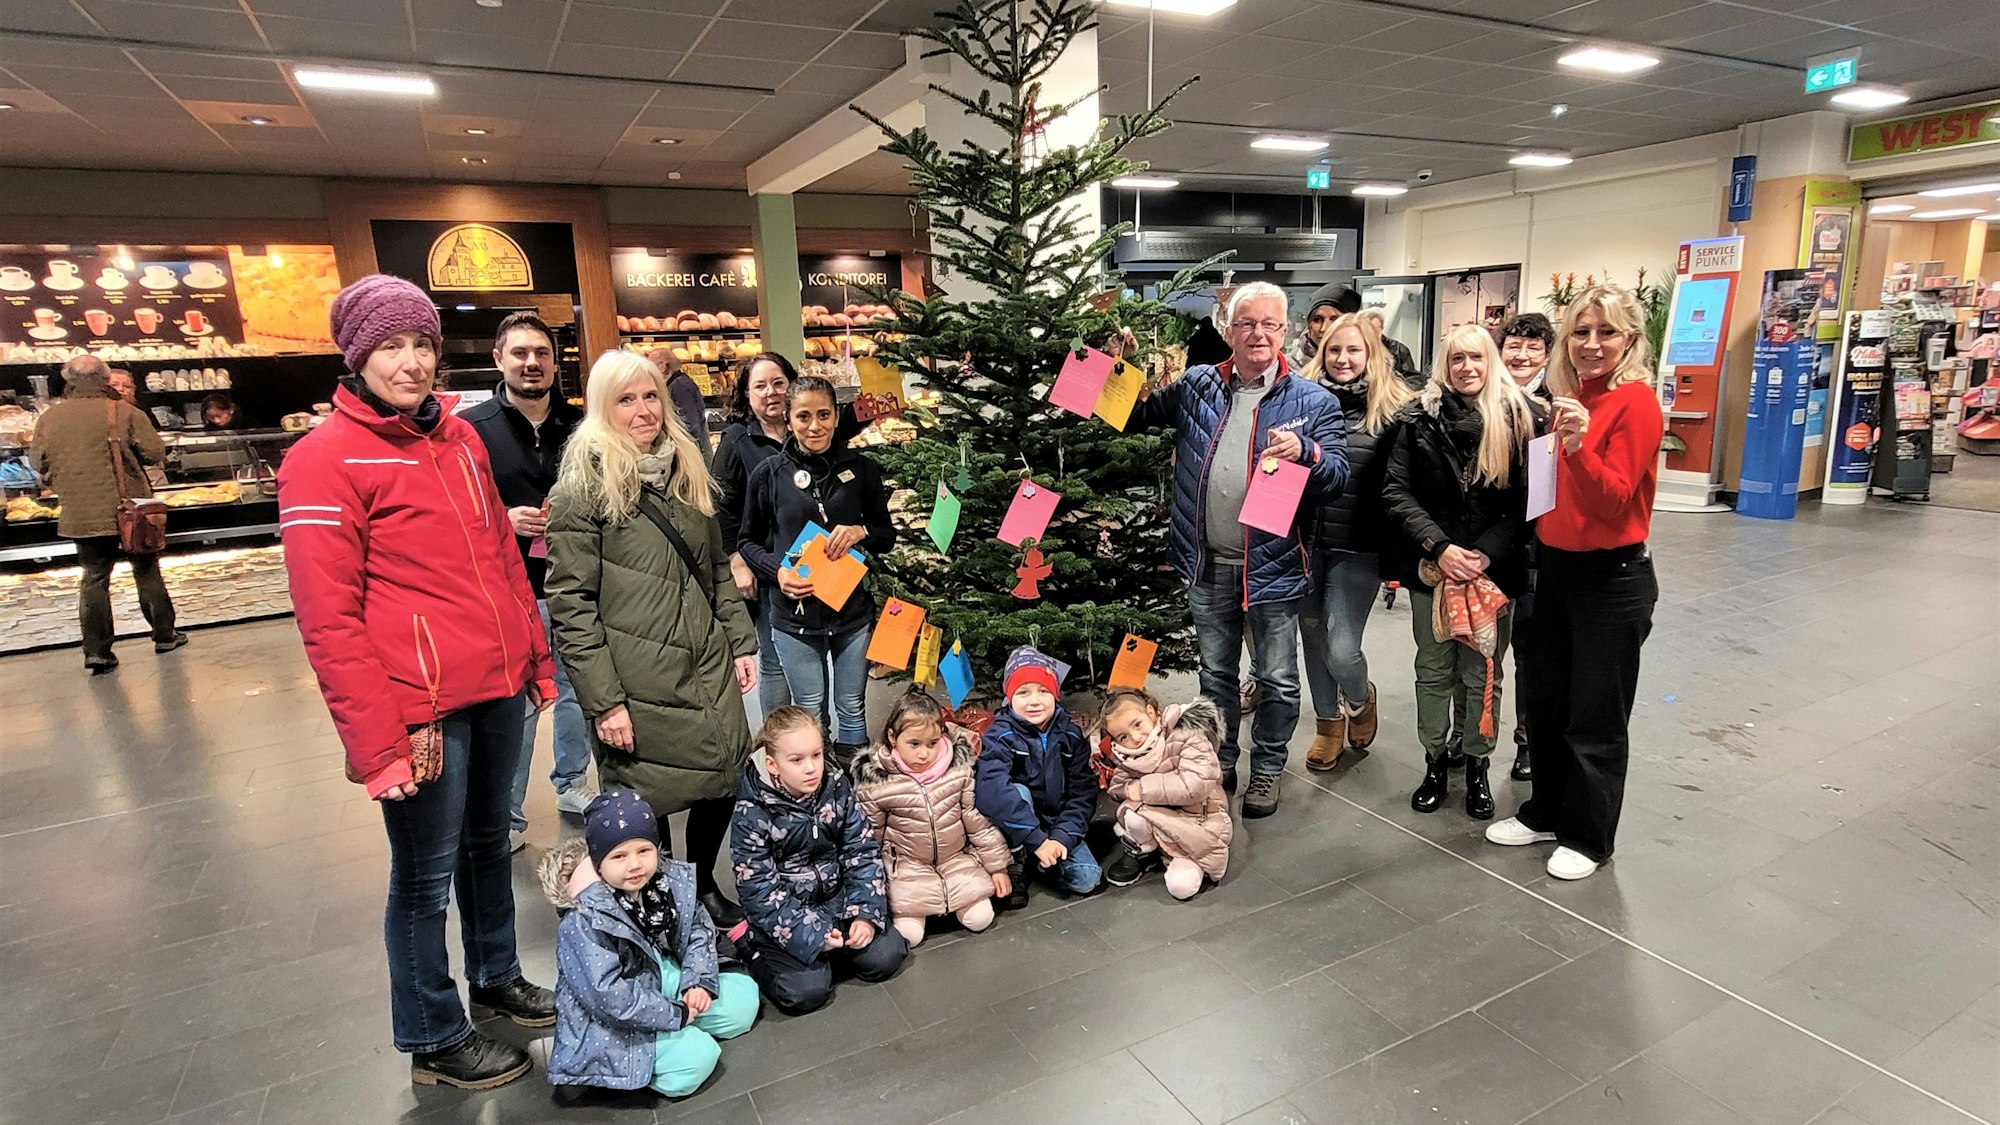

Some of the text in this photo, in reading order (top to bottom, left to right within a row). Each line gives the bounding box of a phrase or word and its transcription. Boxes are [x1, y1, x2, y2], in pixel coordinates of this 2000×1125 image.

[1880, 109, 1988, 152] WEST
[1696, 245, 1736, 257] SERVICE
[1695, 254, 1735, 267] PUNKT
[699, 270, 736, 287] CAFÈ
[808, 272, 887, 286] KONDITOREI
[1772, 325, 1788, 335] 300
